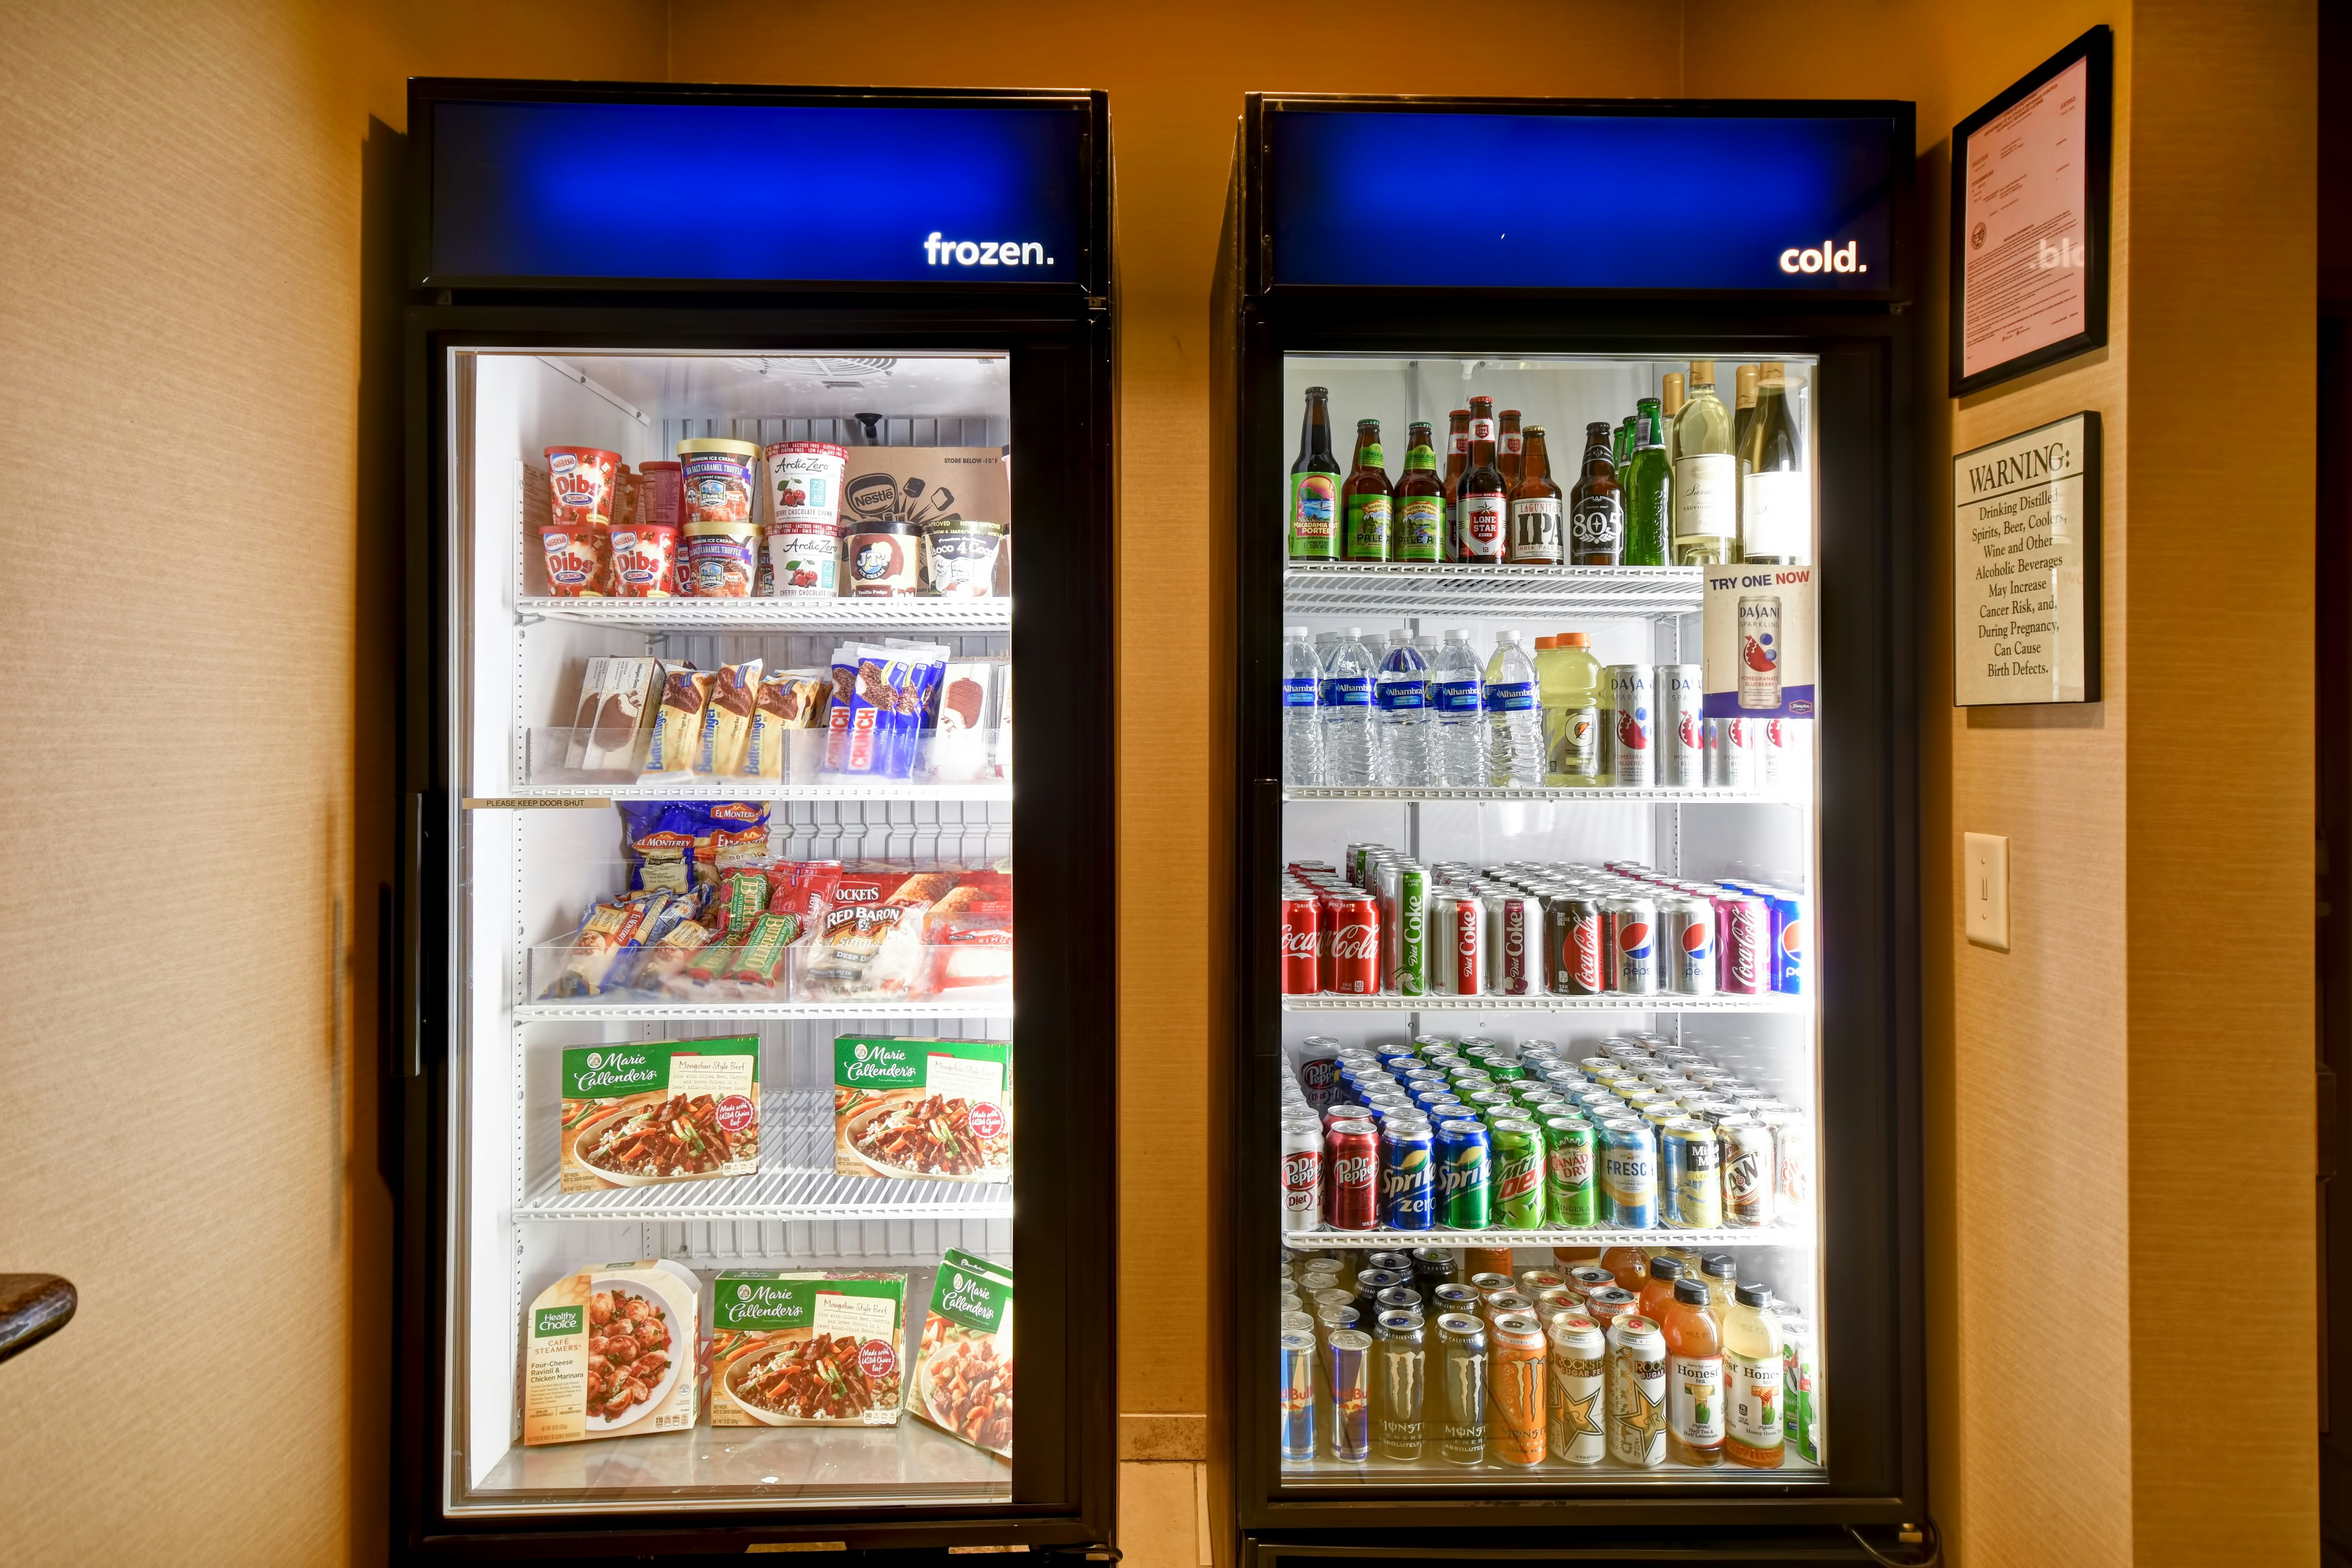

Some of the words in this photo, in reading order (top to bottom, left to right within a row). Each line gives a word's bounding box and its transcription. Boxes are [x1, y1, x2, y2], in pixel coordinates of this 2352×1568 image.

[924, 232, 1054, 265] frozen.
[1780, 240, 1867, 273] cold.
[553, 457, 575, 469] Nestlé
[691, 465, 700, 474] SALT
[701, 463, 723, 471] CARAMEL
[723, 464, 743, 475] TRUFFLE
[775, 458, 806, 473] Arctic
[806, 458, 828, 472] Zero
[1969, 442, 2070, 495] WARNING:
[556, 472, 602, 496] Dibs
[854, 488, 894, 507] Nestlé
[1979, 501, 2018, 521] Drinking
[2020, 488, 2058, 511] Distilled
[1474, 515, 1496, 524] LONE
[1573, 512, 1622, 537] 805
[1972, 526, 2001, 544] Spirits,
[2003, 520, 2026, 535] Beer,
[2028, 511, 2067, 529] Coolers,
[1518, 513, 1563, 546] IPA
[546, 536, 567, 550] Nestlé
[957, 541, 967, 554] 4
[1398, 536, 1423, 544] PALE
[1984, 543, 2006, 559] Wine
[2008, 538, 2024, 554] and
[2026, 534, 2053, 551] Other
[550, 551, 595, 573] Dibs
[1975, 561, 2016, 580] Alcoholic
[2018, 556, 2063, 573] Beverages
[866, 568, 886, 579] CREAM
[1709, 577, 1738, 590] TRY
[1741, 574, 1772, 588] ONE
[1775, 571, 1810, 585] NOW
[1988, 583, 2007, 599] May
[2010, 580, 2047, 595] Increase
[1740, 604, 1779, 621] DASANI
[1980, 604, 2009, 618] Cancer
[2012, 598, 2034, 615] Risk,
[2038, 595, 2057, 611] and,
[1978, 624, 2008, 640] During
[2010, 621, 2059, 637] Pregnancy,
[1994, 643, 2011, 656] Can
[2015, 641, 2041, 655] Cause
[1988, 662, 2009, 677] Birth
[2012, 661, 2048, 676] Defects.
[1499, 690, 1534, 698] Alhambra
[646, 710, 668, 770] Butterfinger
[851, 709, 876, 768] CRUNCH
[836, 887, 878, 901] OCKETS
[827, 908, 854, 927] RED
[855, 906, 900, 923] BARON
[1404, 895, 1422, 944] Coke
[617, 919, 638, 943] MONTEREY
[1459, 911, 1476, 956] Coke
[1506, 912, 1523, 957] Coke
[1408, 945, 1418, 967] Diet
[1464, 957, 1473, 977] Diet
[1509, 957, 1519, 978] Diet
[591, 1052, 646, 1071] Marie
[858, 1046, 906, 1065] Marie
[679, 1060, 711, 1071] Mongolian
[712, 1060, 729, 1072] Style
[730, 1061, 745, 1071] Beef
[844, 1061, 916, 1081] Callender's
[574, 1069, 657, 1092] Callender's
[720, 1105, 735, 1113] Made
[730, 1119, 741, 1127] Beef
[1298, 1157, 1317, 1173] Dr
[1334, 1159, 1378, 1185] Pepper
[1351, 1156, 1369, 1171] Dr
[1563, 1164, 1588, 1178] DRY
[1288, 1195, 1307, 1207] Diet
[1399, 1197, 1436, 1212] zero
[750, 1286, 793, 1305] Marie
[961, 1277, 990, 1301] Marie
[726, 1302, 803, 1323] Callender's
[942, 1288, 994, 1320] Callender's
[539, 1319, 577, 1330] Choice
[544, 1312, 576, 1322] Healthy
[535, 1344, 578, 1355] STEAMERS
[548, 1337, 569, 1347] CAFÉ
[531, 1359, 573, 1369] Four-Cheese
[531, 1368, 554, 1377] Ravioli
[1561, 1367, 1590, 1377] SUGAR
[1677, 1364, 1718, 1378] Honest
[531, 1374, 556, 1383] Chicken
[557, 1371, 583, 1380] Marinara
[1445, 1444, 1486, 1452] ABSOLUTELY
